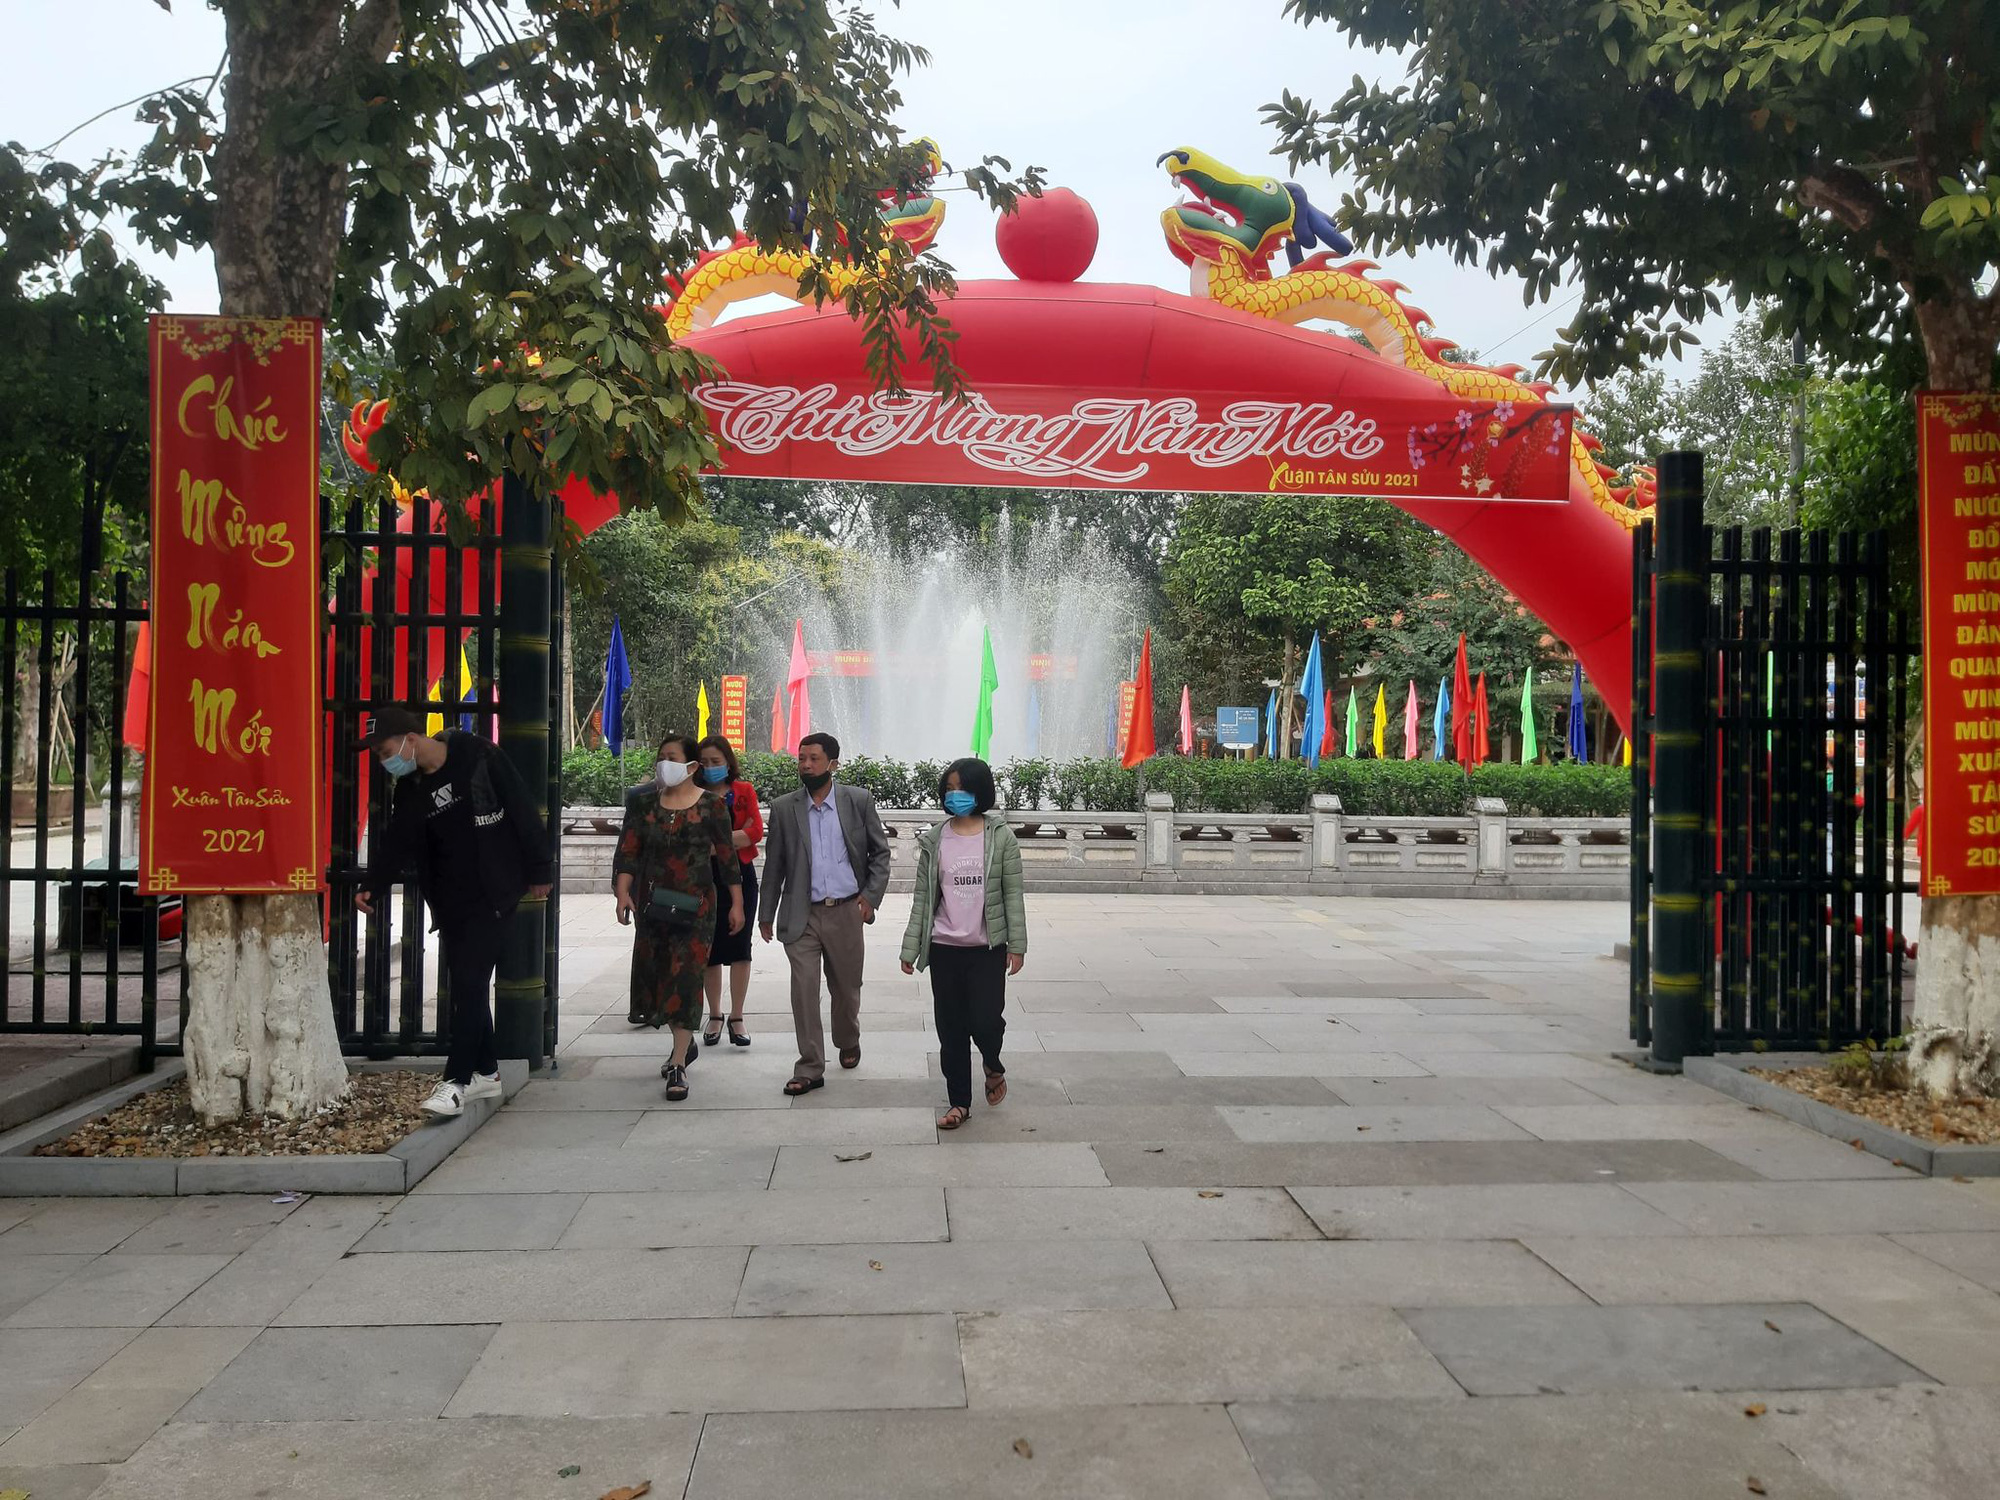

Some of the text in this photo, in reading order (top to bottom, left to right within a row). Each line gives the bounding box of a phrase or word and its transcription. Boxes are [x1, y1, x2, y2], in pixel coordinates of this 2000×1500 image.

[178, 373, 288, 451] Chúc
[1221, 399, 1385, 461] Mới
[1317, 468, 1348, 486] TÂN
[1351, 468, 1381, 487] SỬU
[1384, 473, 1419, 488] 2021
[1963, 459, 2000, 485] ĐẤ
[176, 468, 295, 568] Mừng
[1949, 657, 2000, 680] QUA
[187, 677, 274, 764] Mới
[171, 785, 293, 809] Xuân Tân Sửu
[1967, 780, 2000, 804] TÂ
[202, 828, 266, 854] 2021
[1966, 846, 2000, 868] 20
[953, 875, 983, 887] SUGAR
